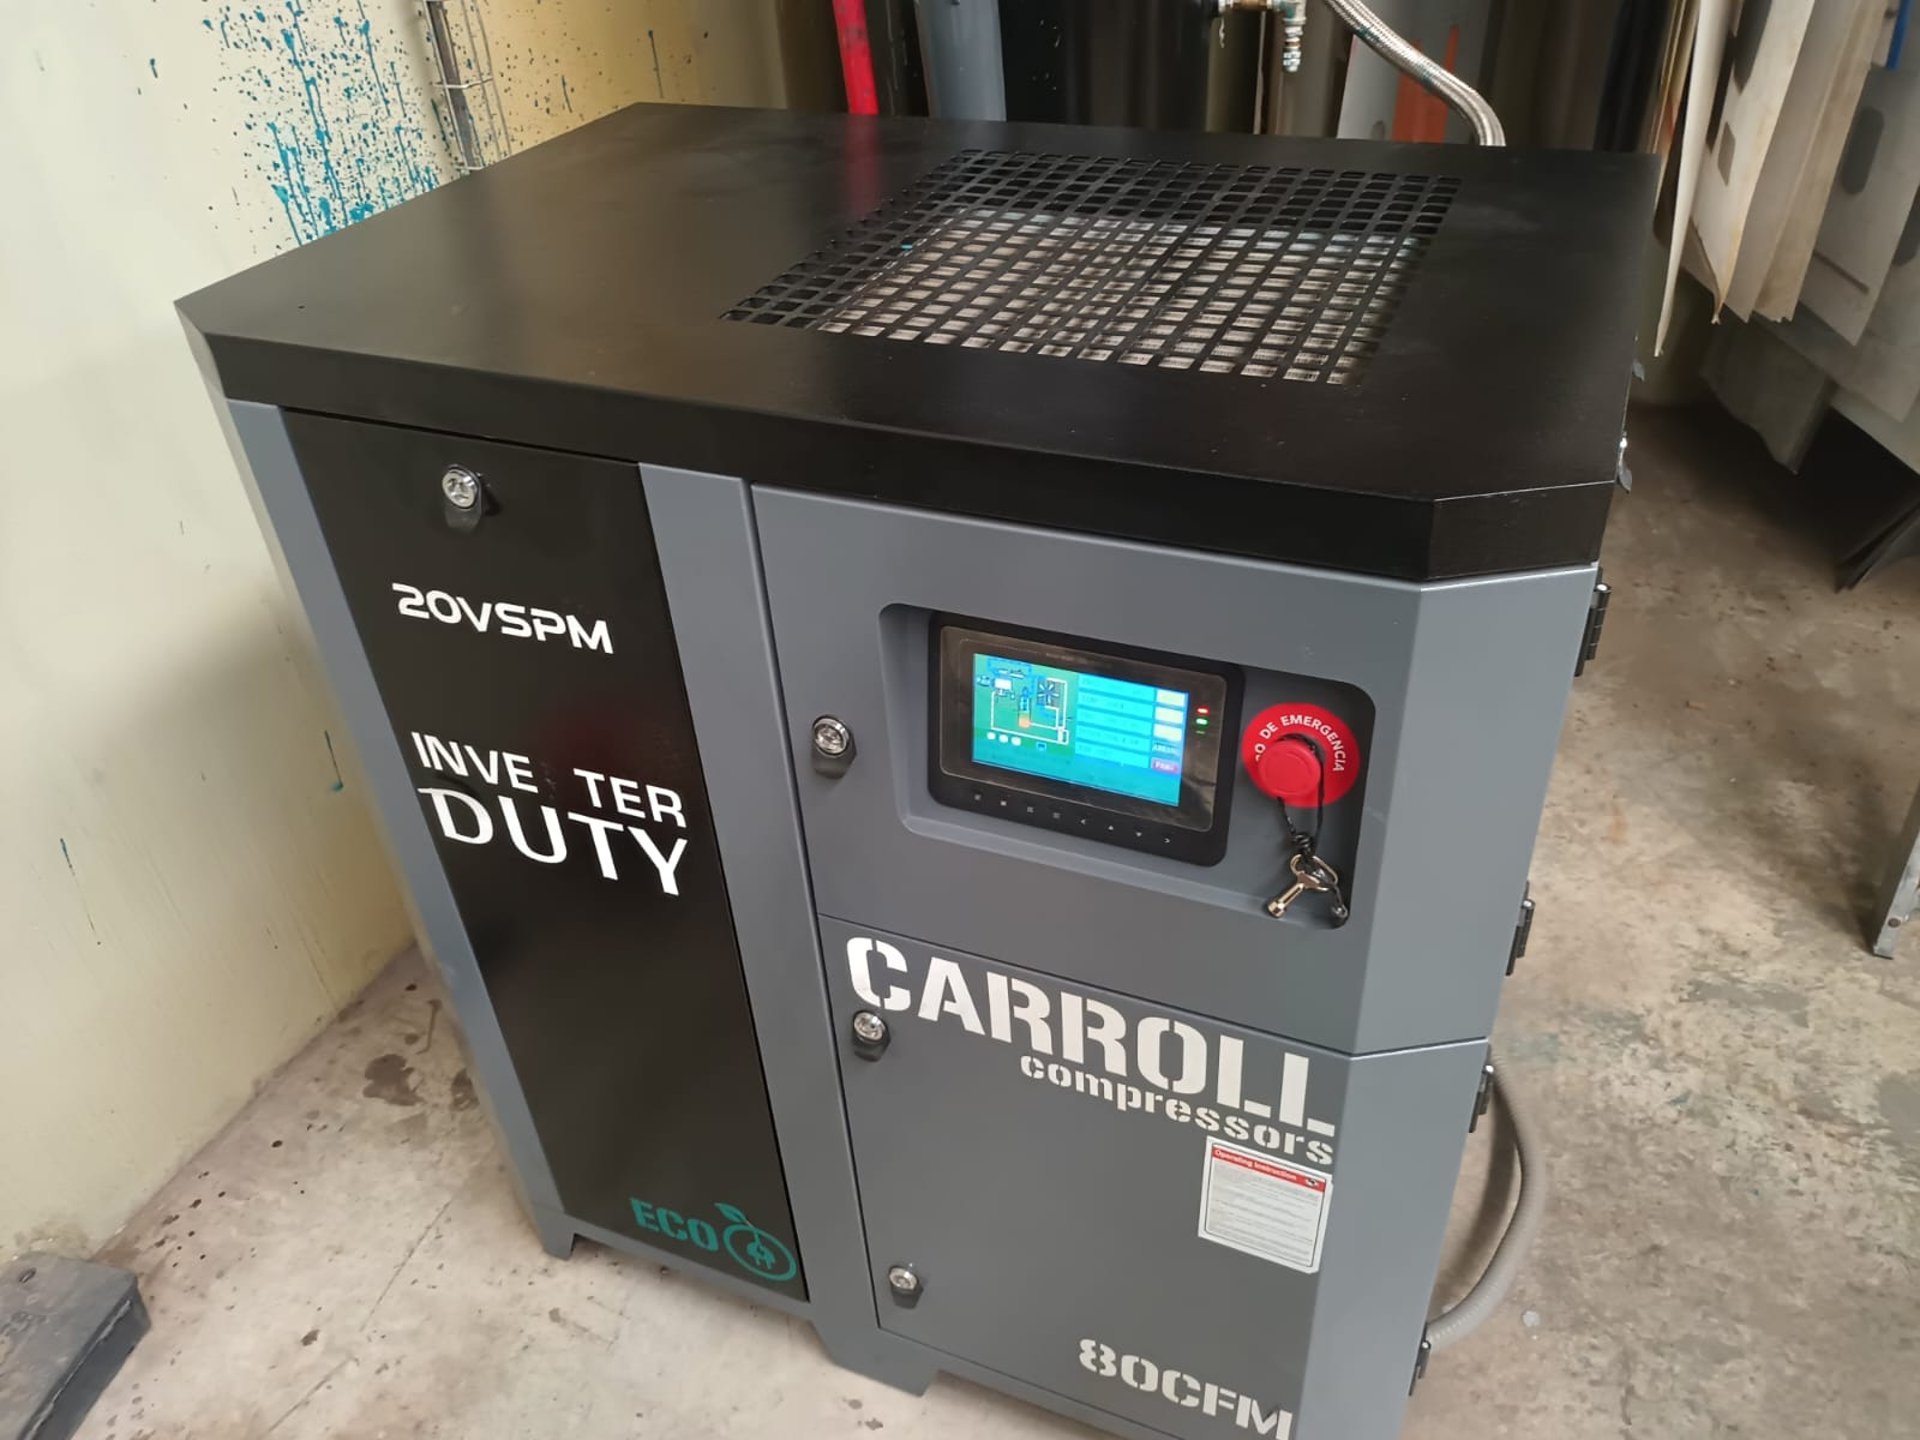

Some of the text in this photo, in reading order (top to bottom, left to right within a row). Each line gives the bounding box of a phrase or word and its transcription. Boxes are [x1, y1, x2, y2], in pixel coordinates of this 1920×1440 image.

[392, 582, 614, 654] 20VSPM
[1259, 722, 1279, 739] DE
[1280, 714, 1347, 772] EMERGENCIA
[417, 787, 689, 897] DUTY
[846, 936, 1335, 1137] CARROLL
[1020, 1054, 1333, 1166] compressors
[629, 1197, 720, 1253] ECO
[1079, 1338, 1294, 1440] 80CFM
